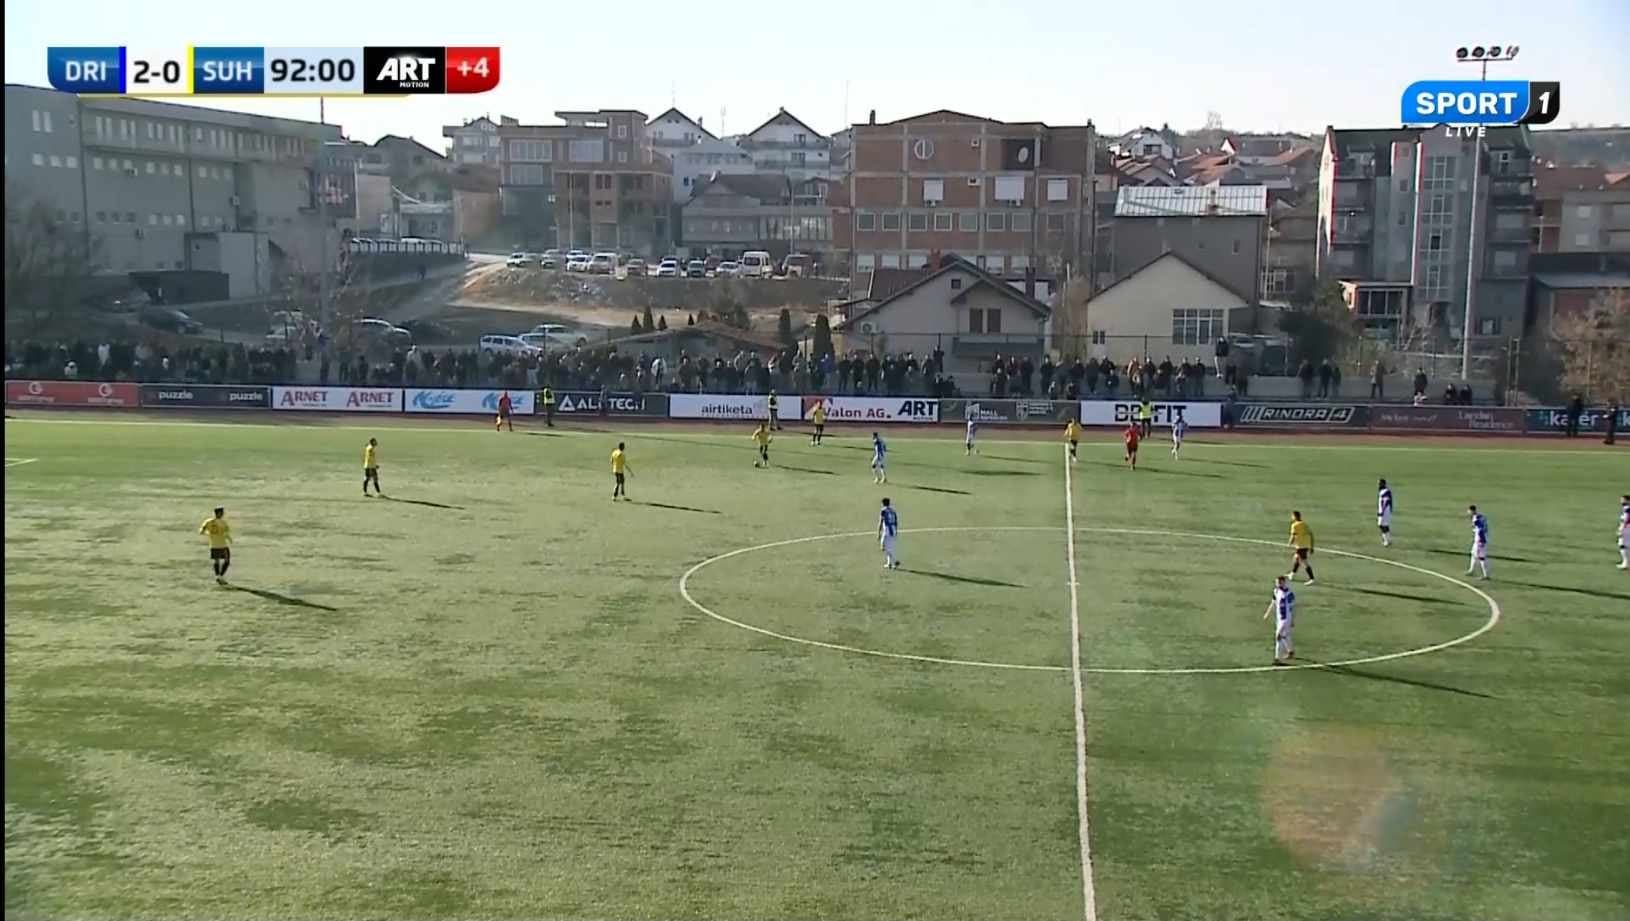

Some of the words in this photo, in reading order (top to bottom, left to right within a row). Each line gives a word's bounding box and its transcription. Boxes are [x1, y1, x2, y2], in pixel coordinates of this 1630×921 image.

[158, 390, 194, 401] puzzle
[229, 391, 264, 402] puzzle
[280, 390, 328, 407] ARNET
[346, 391, 395, 408] ARNET
[897, 400, 938, 416] ART
